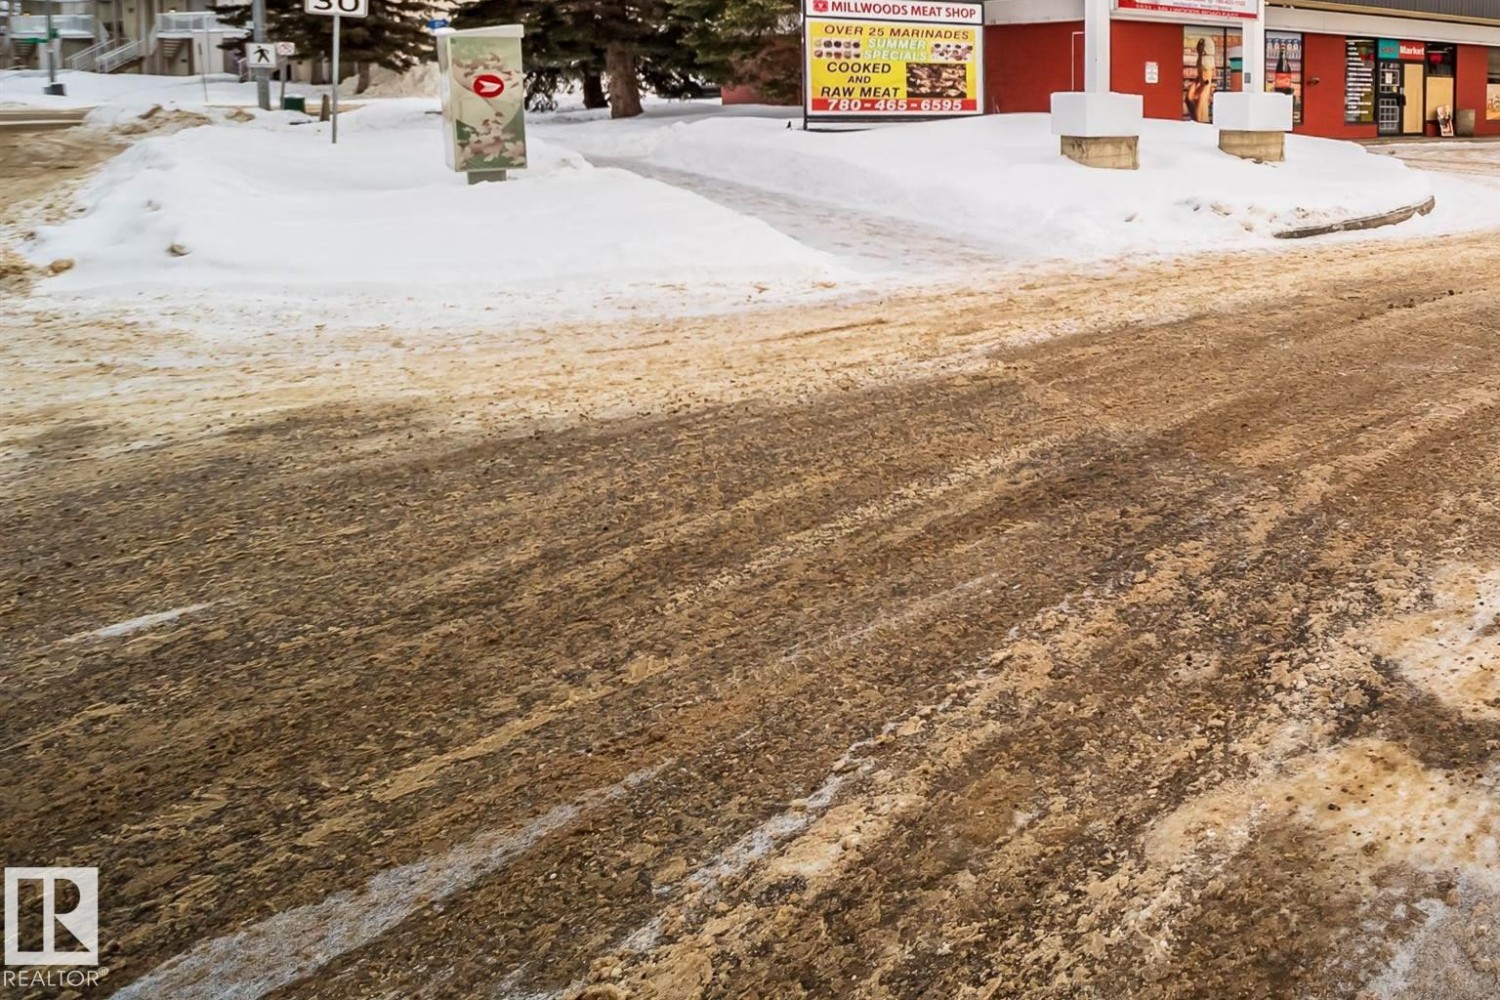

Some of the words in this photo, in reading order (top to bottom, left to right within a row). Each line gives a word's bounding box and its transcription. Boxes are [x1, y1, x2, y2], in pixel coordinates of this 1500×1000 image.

[831, 1, 908, 15] MILLWOODS
[911, 6, 942, 17] MEAT
[945, 8, 976, 19] SHOP
[824, 24, 863, 36] OVER
[869, 26, 885, 37] 25
[889, 27, 970, 40] MARINADES
[867, 38, 927, 49] SUMMER
[864, 50, 928, 61] SPECIALS
[1400, 45, 1425, 55] Market
[826, 61, 891, 74] COOKED
[847, 75, 871, 84] AND
[821, 86, 854, 98] RAW
[860, 87, 900, 99] MEAT
